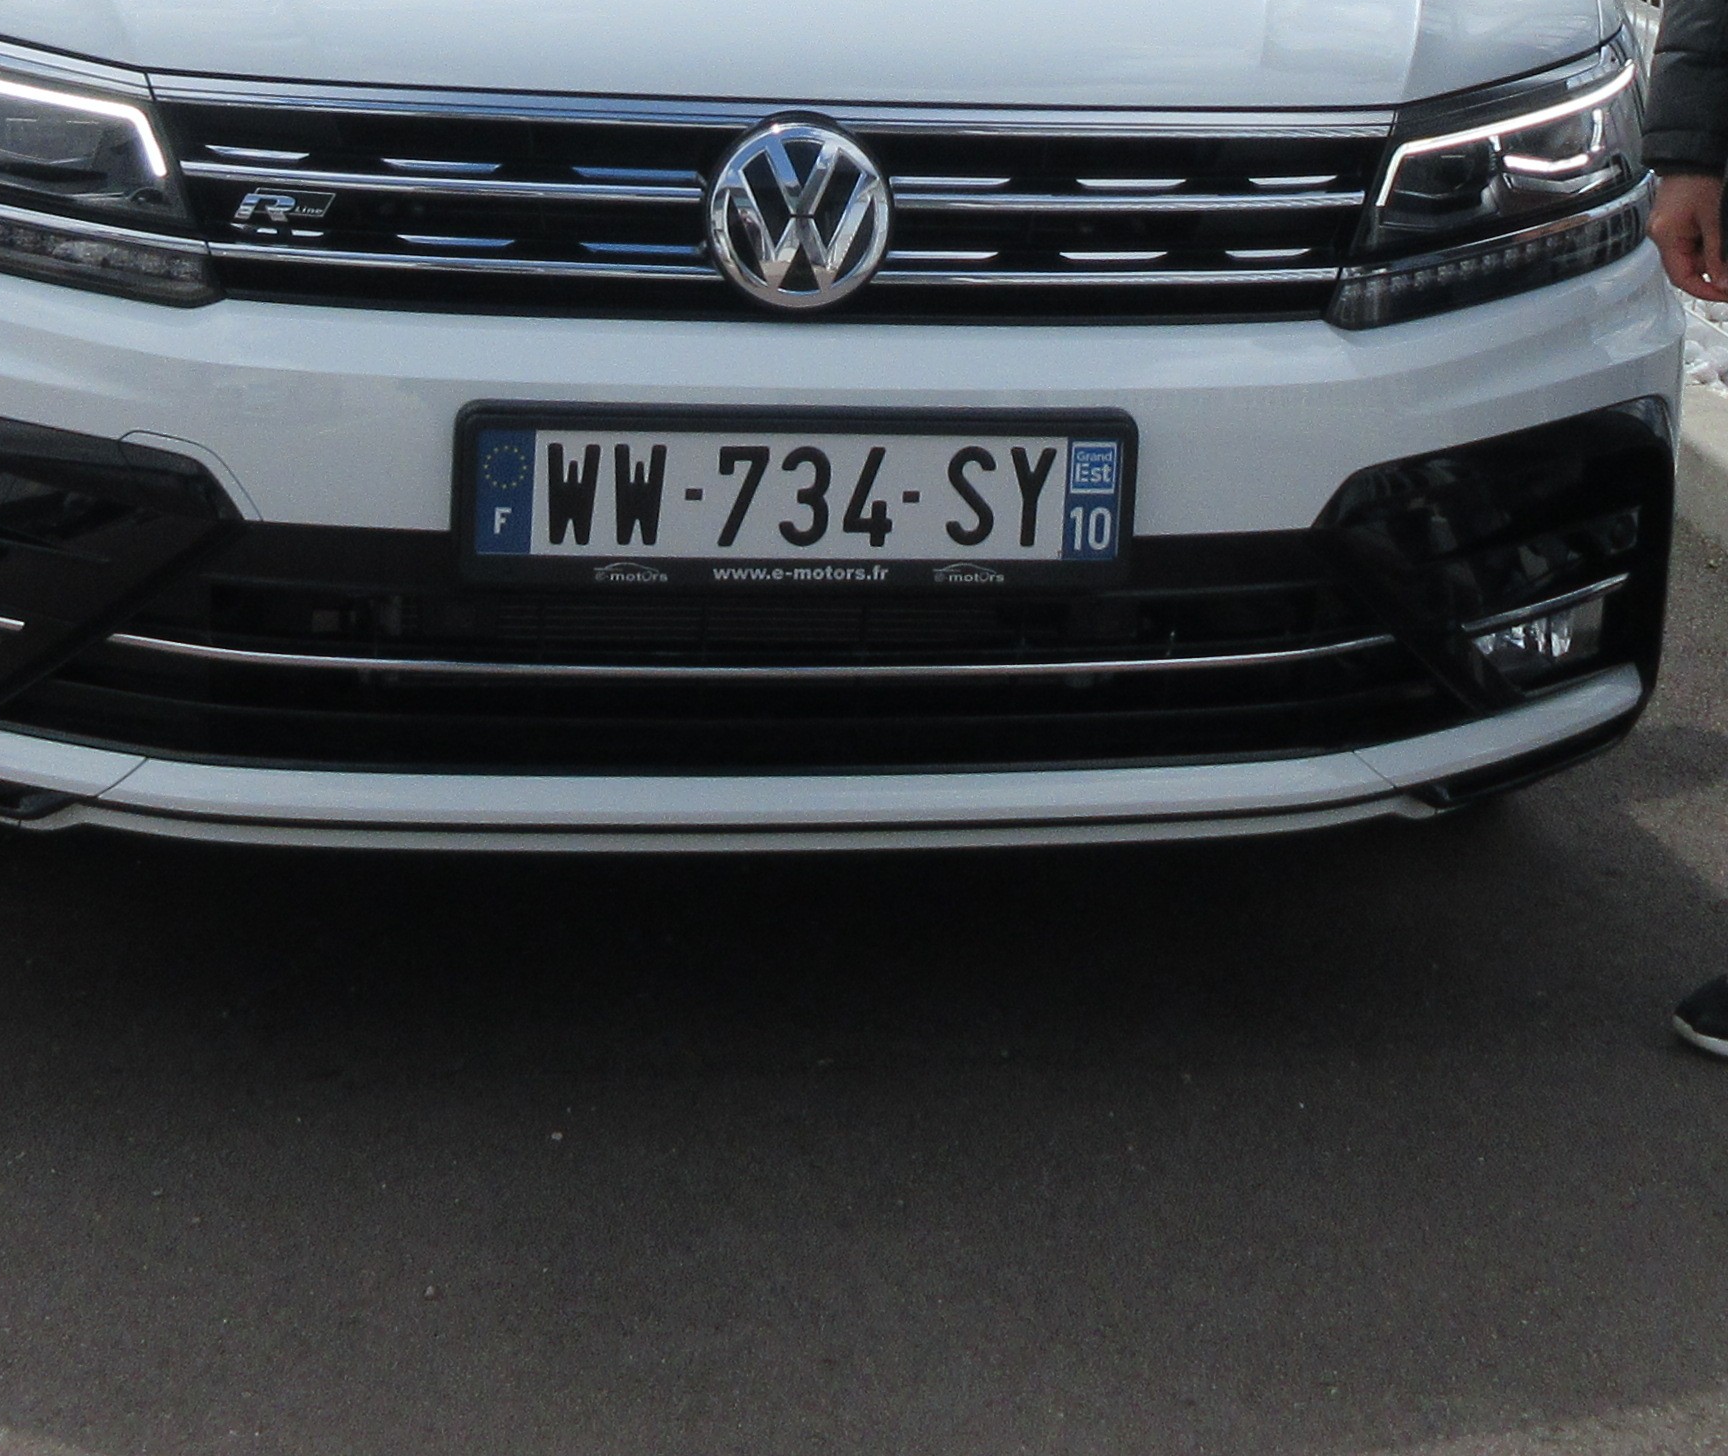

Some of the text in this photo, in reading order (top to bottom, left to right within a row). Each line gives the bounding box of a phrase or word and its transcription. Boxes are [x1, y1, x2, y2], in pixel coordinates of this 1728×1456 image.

[234, 193, 296, 222] R
[712, 124, 888, 307] VW
[1076, 450, 1113, 462] Grand
[1075, 463, 1112, 483] Est
[547, 442, 1057, 547] WW-734-SY
[494, 507, 512, 535] F
[1070, 506, 1112, 551] 10
[713, 565, 889, 581] www.e-motors.fr
